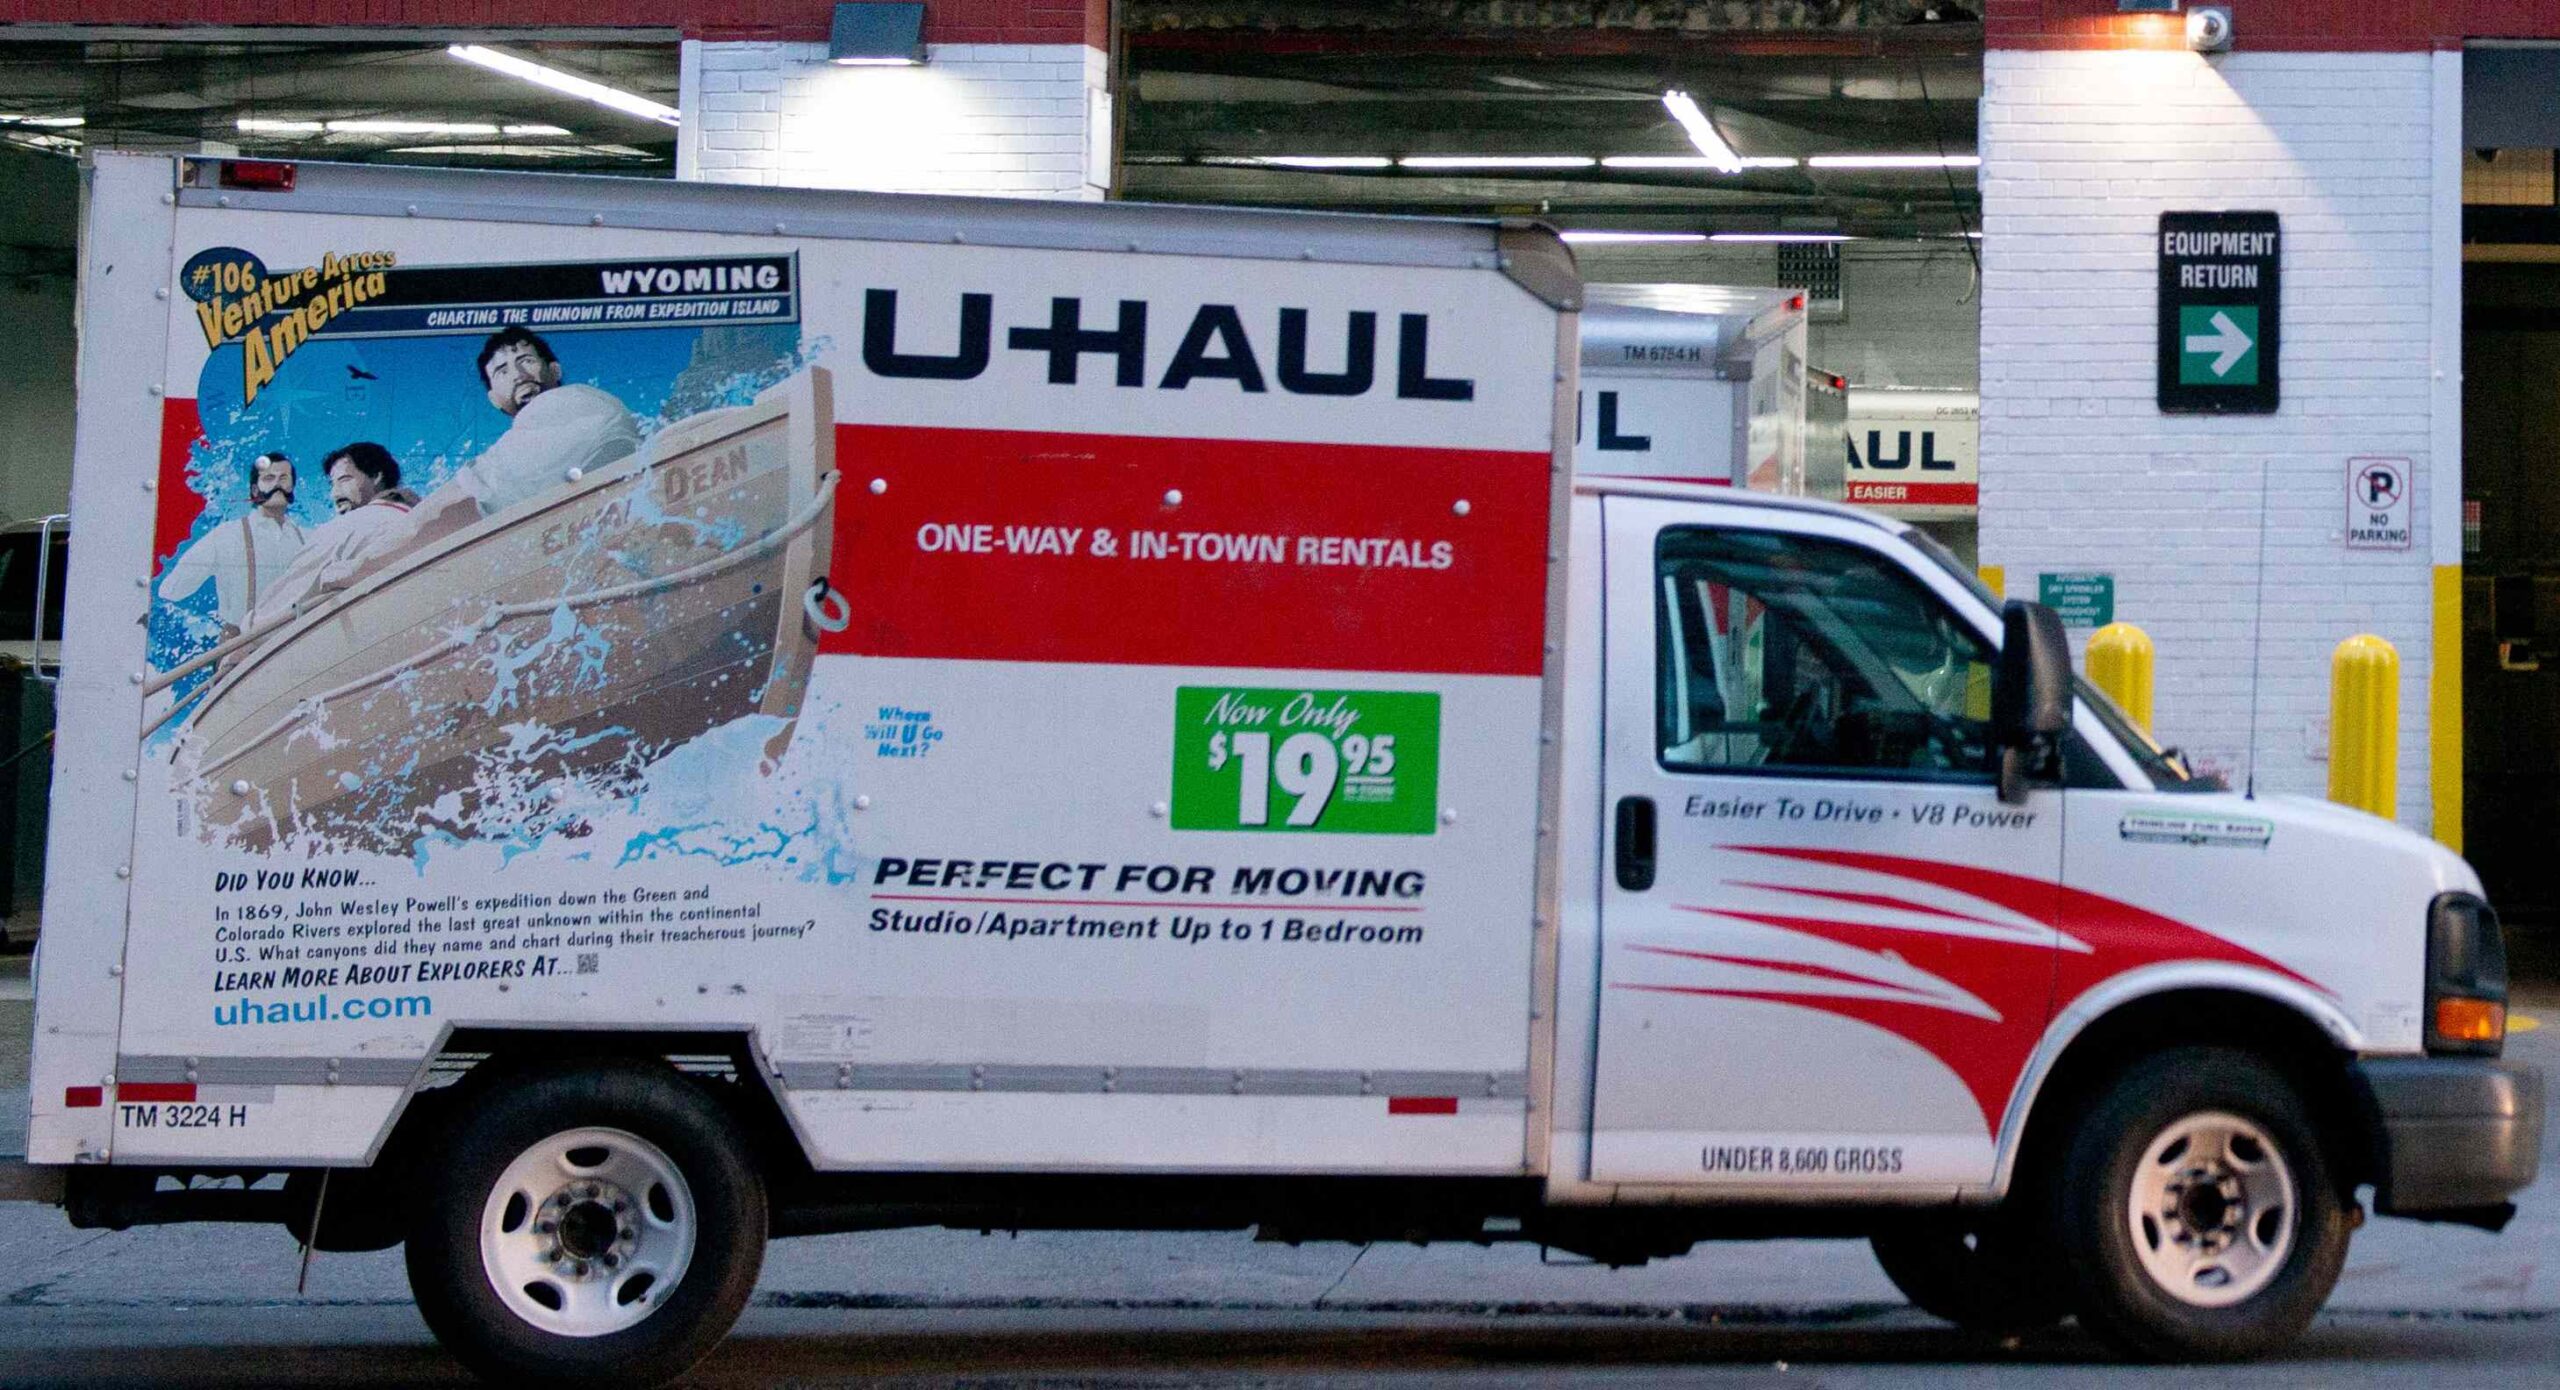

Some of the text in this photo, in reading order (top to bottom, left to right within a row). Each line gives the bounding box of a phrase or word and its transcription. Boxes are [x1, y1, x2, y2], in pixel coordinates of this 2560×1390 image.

[2164, 232, 2275, 256] EQUIPMENT
[192, 261, 256, 294] #106
[601, 265, 781, 294] WYOMING
[2181, 264, 2258, 288] RETURN
[196, 250, 396, 349] Venture Across
[427, 298, 781, 326] CHARTING THE UNKNOWN FROM EXPEDITION ISLAND
[244, 271, 386, 408] America
[862, 288, 1475, 402] U-HAUL
[1623, 345, 1646, 361] TM
[664, 445, 748, 504] DEAN
[1853, 485, 1908, 500] EASIER
[2350, 529, 2407, 542] PARKING
[2370, 513, 2388, 526] NO
[917, 522, 1454, 571] ONE-WAY & IN-TOWN RENTALS
[1203, 691, 1361, 741] Now Only
[877, 742, 930, 758] Next?
[902, 724, 918, 745] U
[922, 726, 943, 741] Go
[1684, 795, 2038, 829] Easier To Drive V8 Power
[873, 857, 1426, 898] PERFECT FOR MOVING
[215, 884, 710, 921] In 1869, John Wesley Powell's expedition down the Green and
[215, 902, 761, 942] Colorado Rivers explored the last great unknown within the continental
[868, 908, 1424, 944] Studio/Apartment Up to 1 Bedroom
[215, 919, 816, 963] U.S. What canyons did they name and chart during their treacherous journey?
[214, 993, 432, 1026] uhaul.com
[120, 1104, 247, 1127] TM 3224 H
[1701, 1146, 1904, 1174] UNDER 8,600 GROSS
